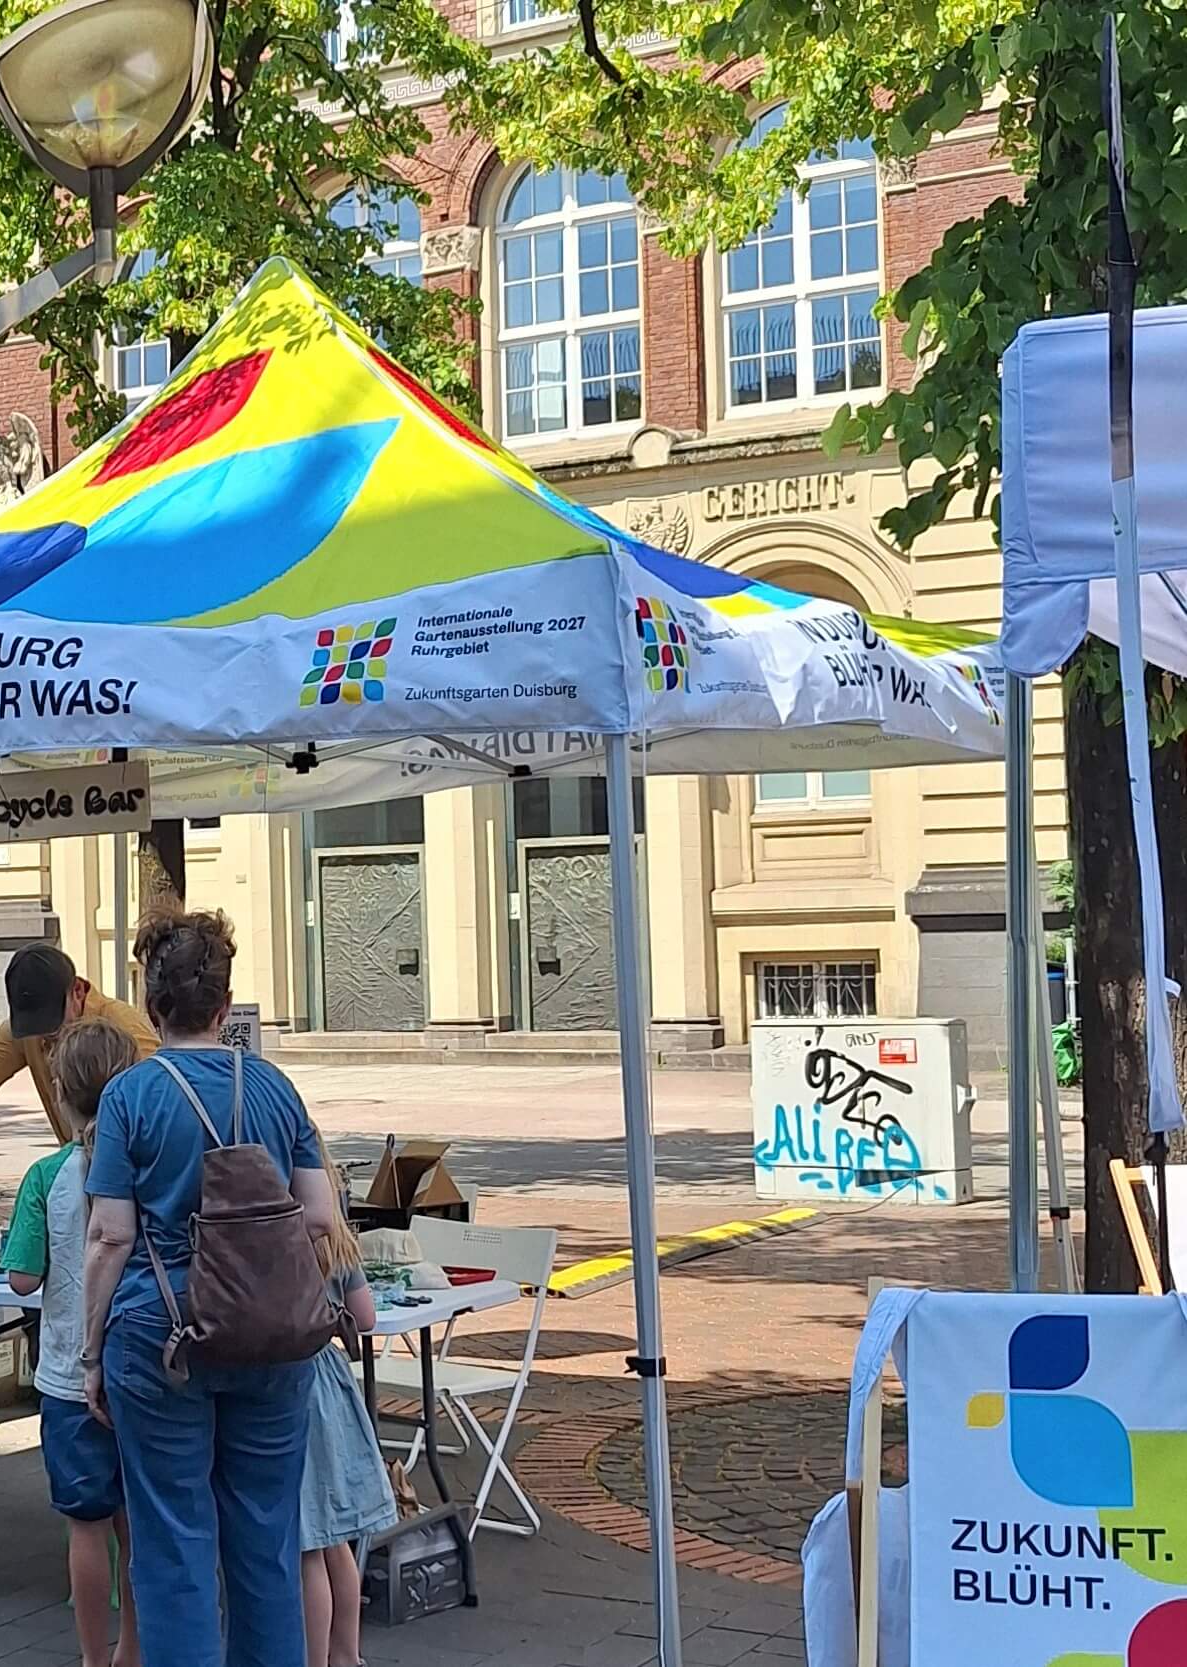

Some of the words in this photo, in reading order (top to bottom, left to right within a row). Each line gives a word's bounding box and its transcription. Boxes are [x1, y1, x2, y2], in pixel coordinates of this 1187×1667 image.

[414, 620, 544, 643] Gartenausstellung
[547, 616, 587, 632] 2027
[417, 606, 513, 629] Internationale
[411, 641, 490, 659] Ruhrgebiet
[31, 678, 139, 718] WAS!
[405, 685, 509, 703] Zukunftsgarten
[513, 683, 577, 700] Duisburg
[84, 785, 146, 817] Bar
[950, 1518, 1174, 1562] ZUKUNFT.
[953, 1563, 1111, 1611] BLÜHT.
